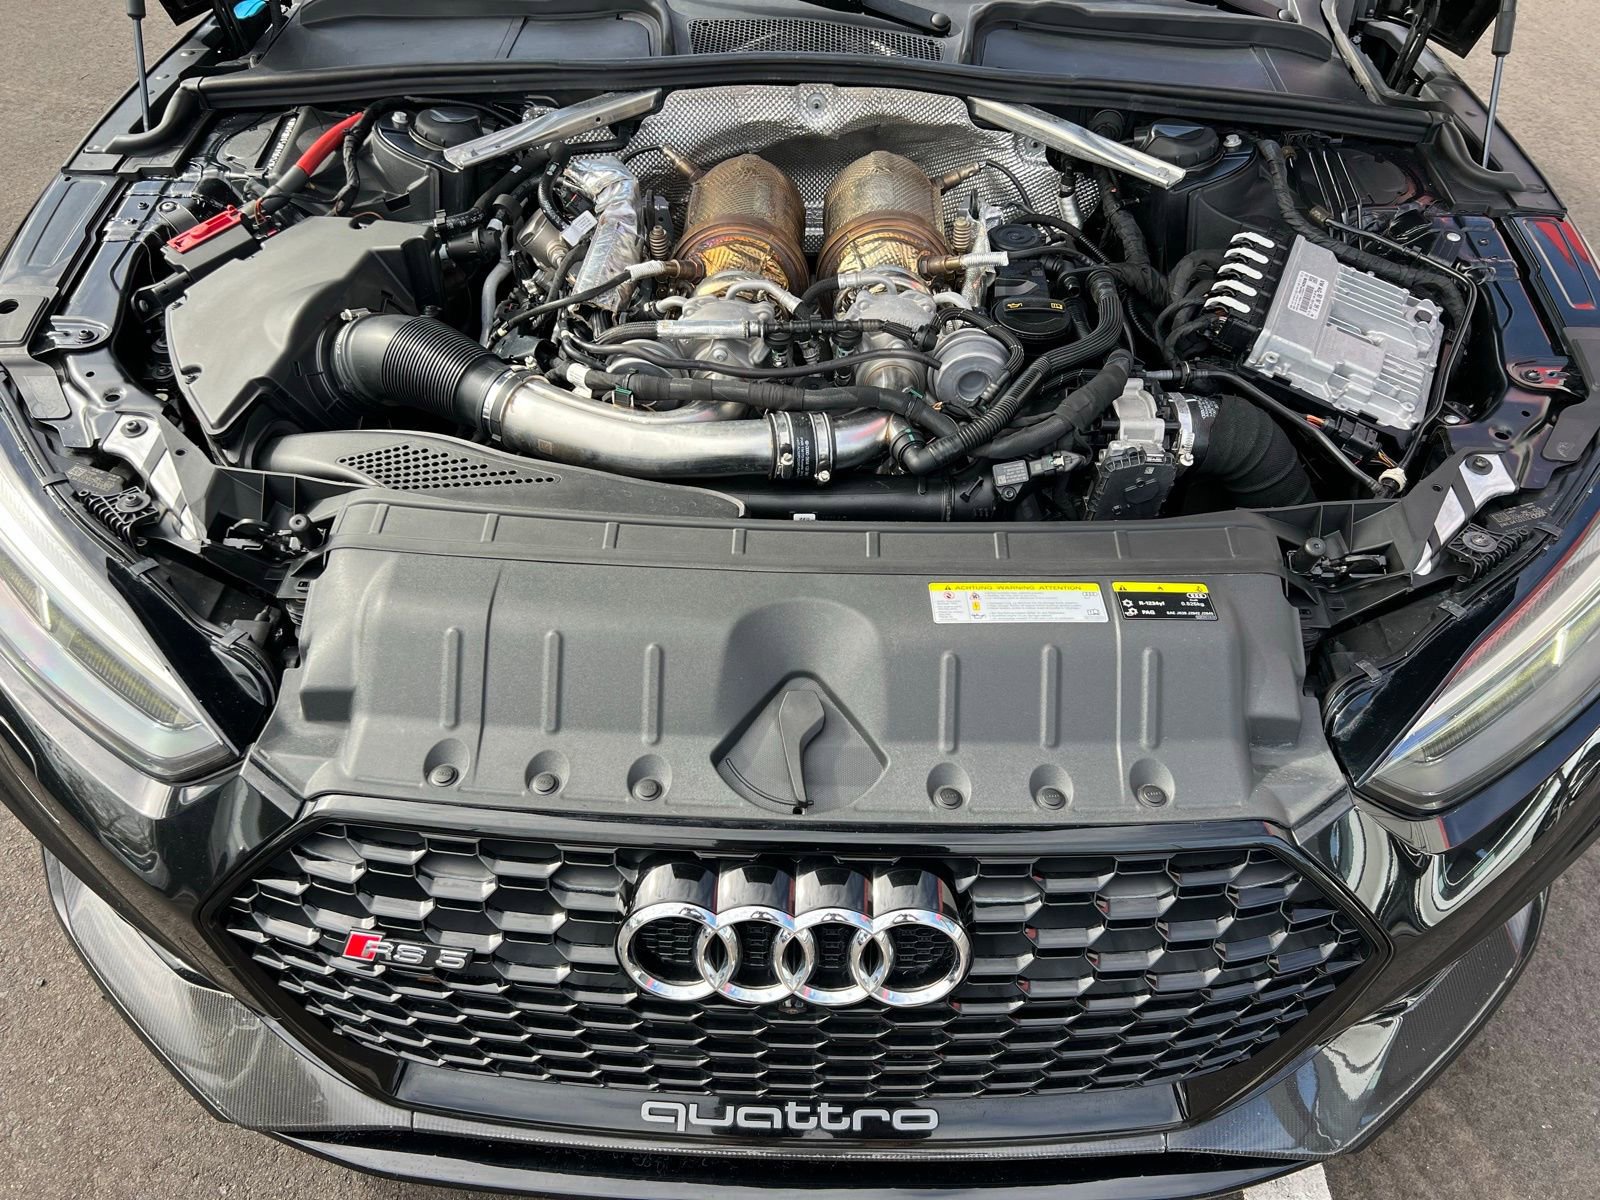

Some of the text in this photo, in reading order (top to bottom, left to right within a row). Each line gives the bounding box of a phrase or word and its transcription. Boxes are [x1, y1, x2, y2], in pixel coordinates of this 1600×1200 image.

[362, 939, 468, 969] RS 5
[640, 1101, 939, 1132] quattro
